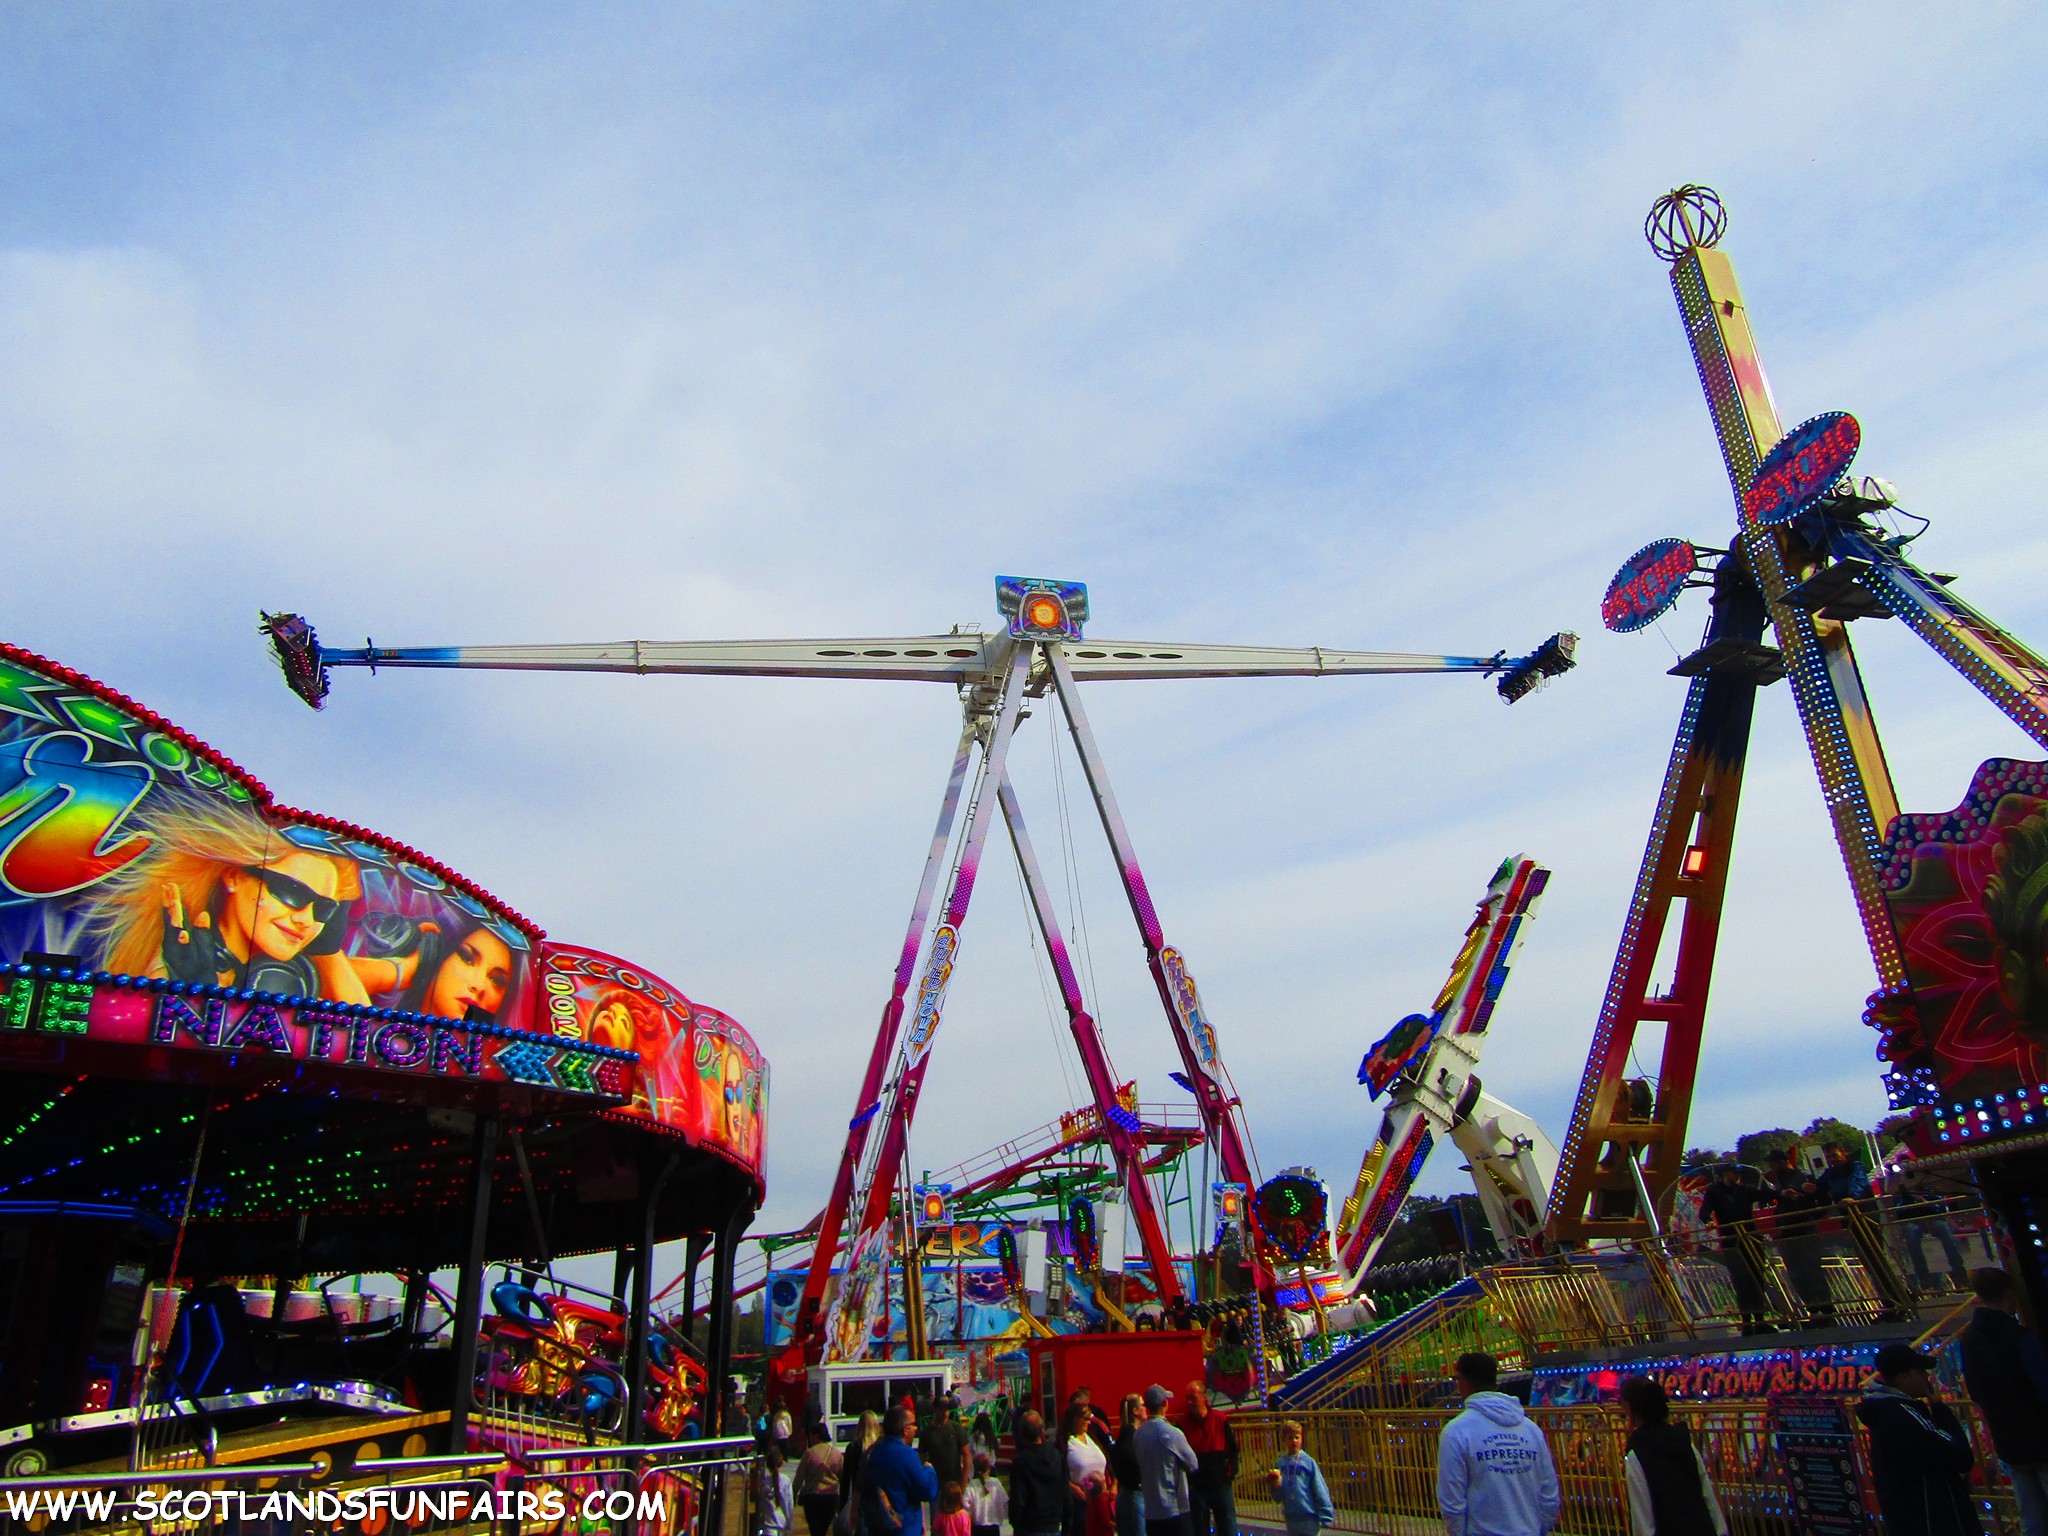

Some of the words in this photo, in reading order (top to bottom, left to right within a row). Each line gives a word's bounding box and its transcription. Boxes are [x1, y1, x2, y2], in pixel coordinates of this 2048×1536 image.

[1743, 413, 1860, 524] PSYCHO
[153, 994, 484, 1077] NATION
[1698, 1366, 1766, 1396] Crow
[1770, 1362, 1796, 1393] &
[1800, 1358, 1876, 1392] Sons
[1811, 1407, 1836, 1417] HEIGHT
[1482, 1433, 1518, 1445] POWERED
[1476, 1448, 1537, 1462] REPRESENT
